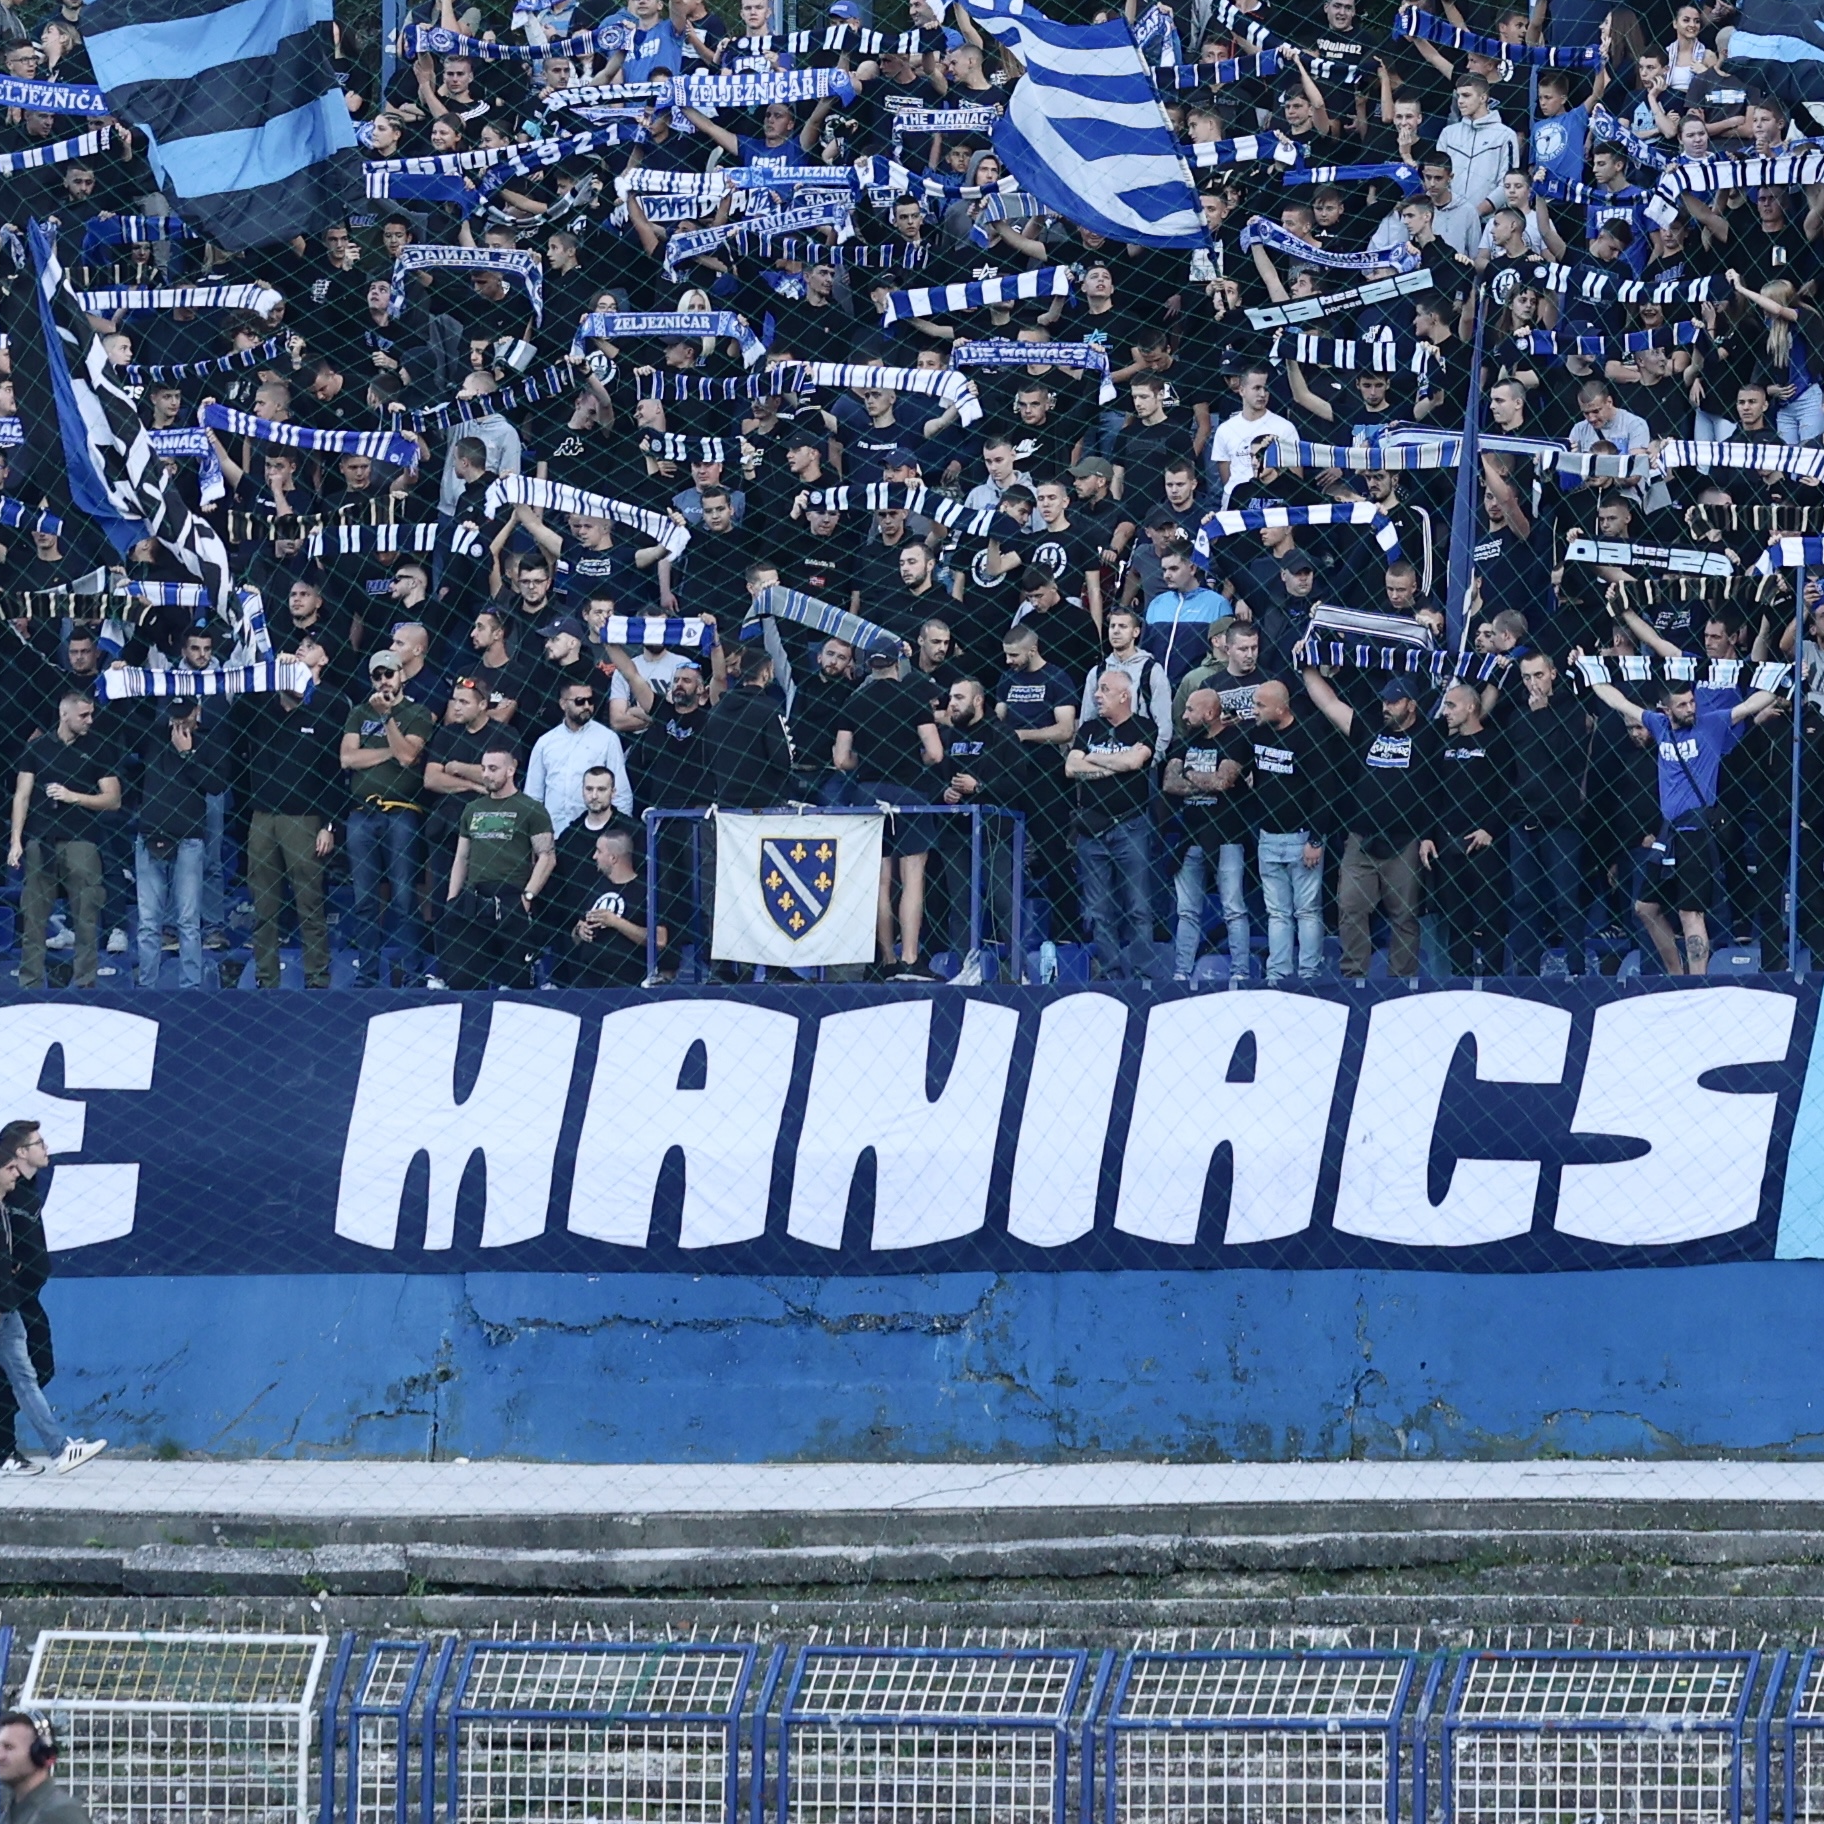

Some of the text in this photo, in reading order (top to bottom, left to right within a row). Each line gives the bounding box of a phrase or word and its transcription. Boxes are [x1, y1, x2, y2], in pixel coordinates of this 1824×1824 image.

[643, 194, 697, 219] DEVET
[958, 346, 995, 359] THE
[152, 433, 210, 452] ANIACS
[333, 985, 1800, 1252] MANIACS
